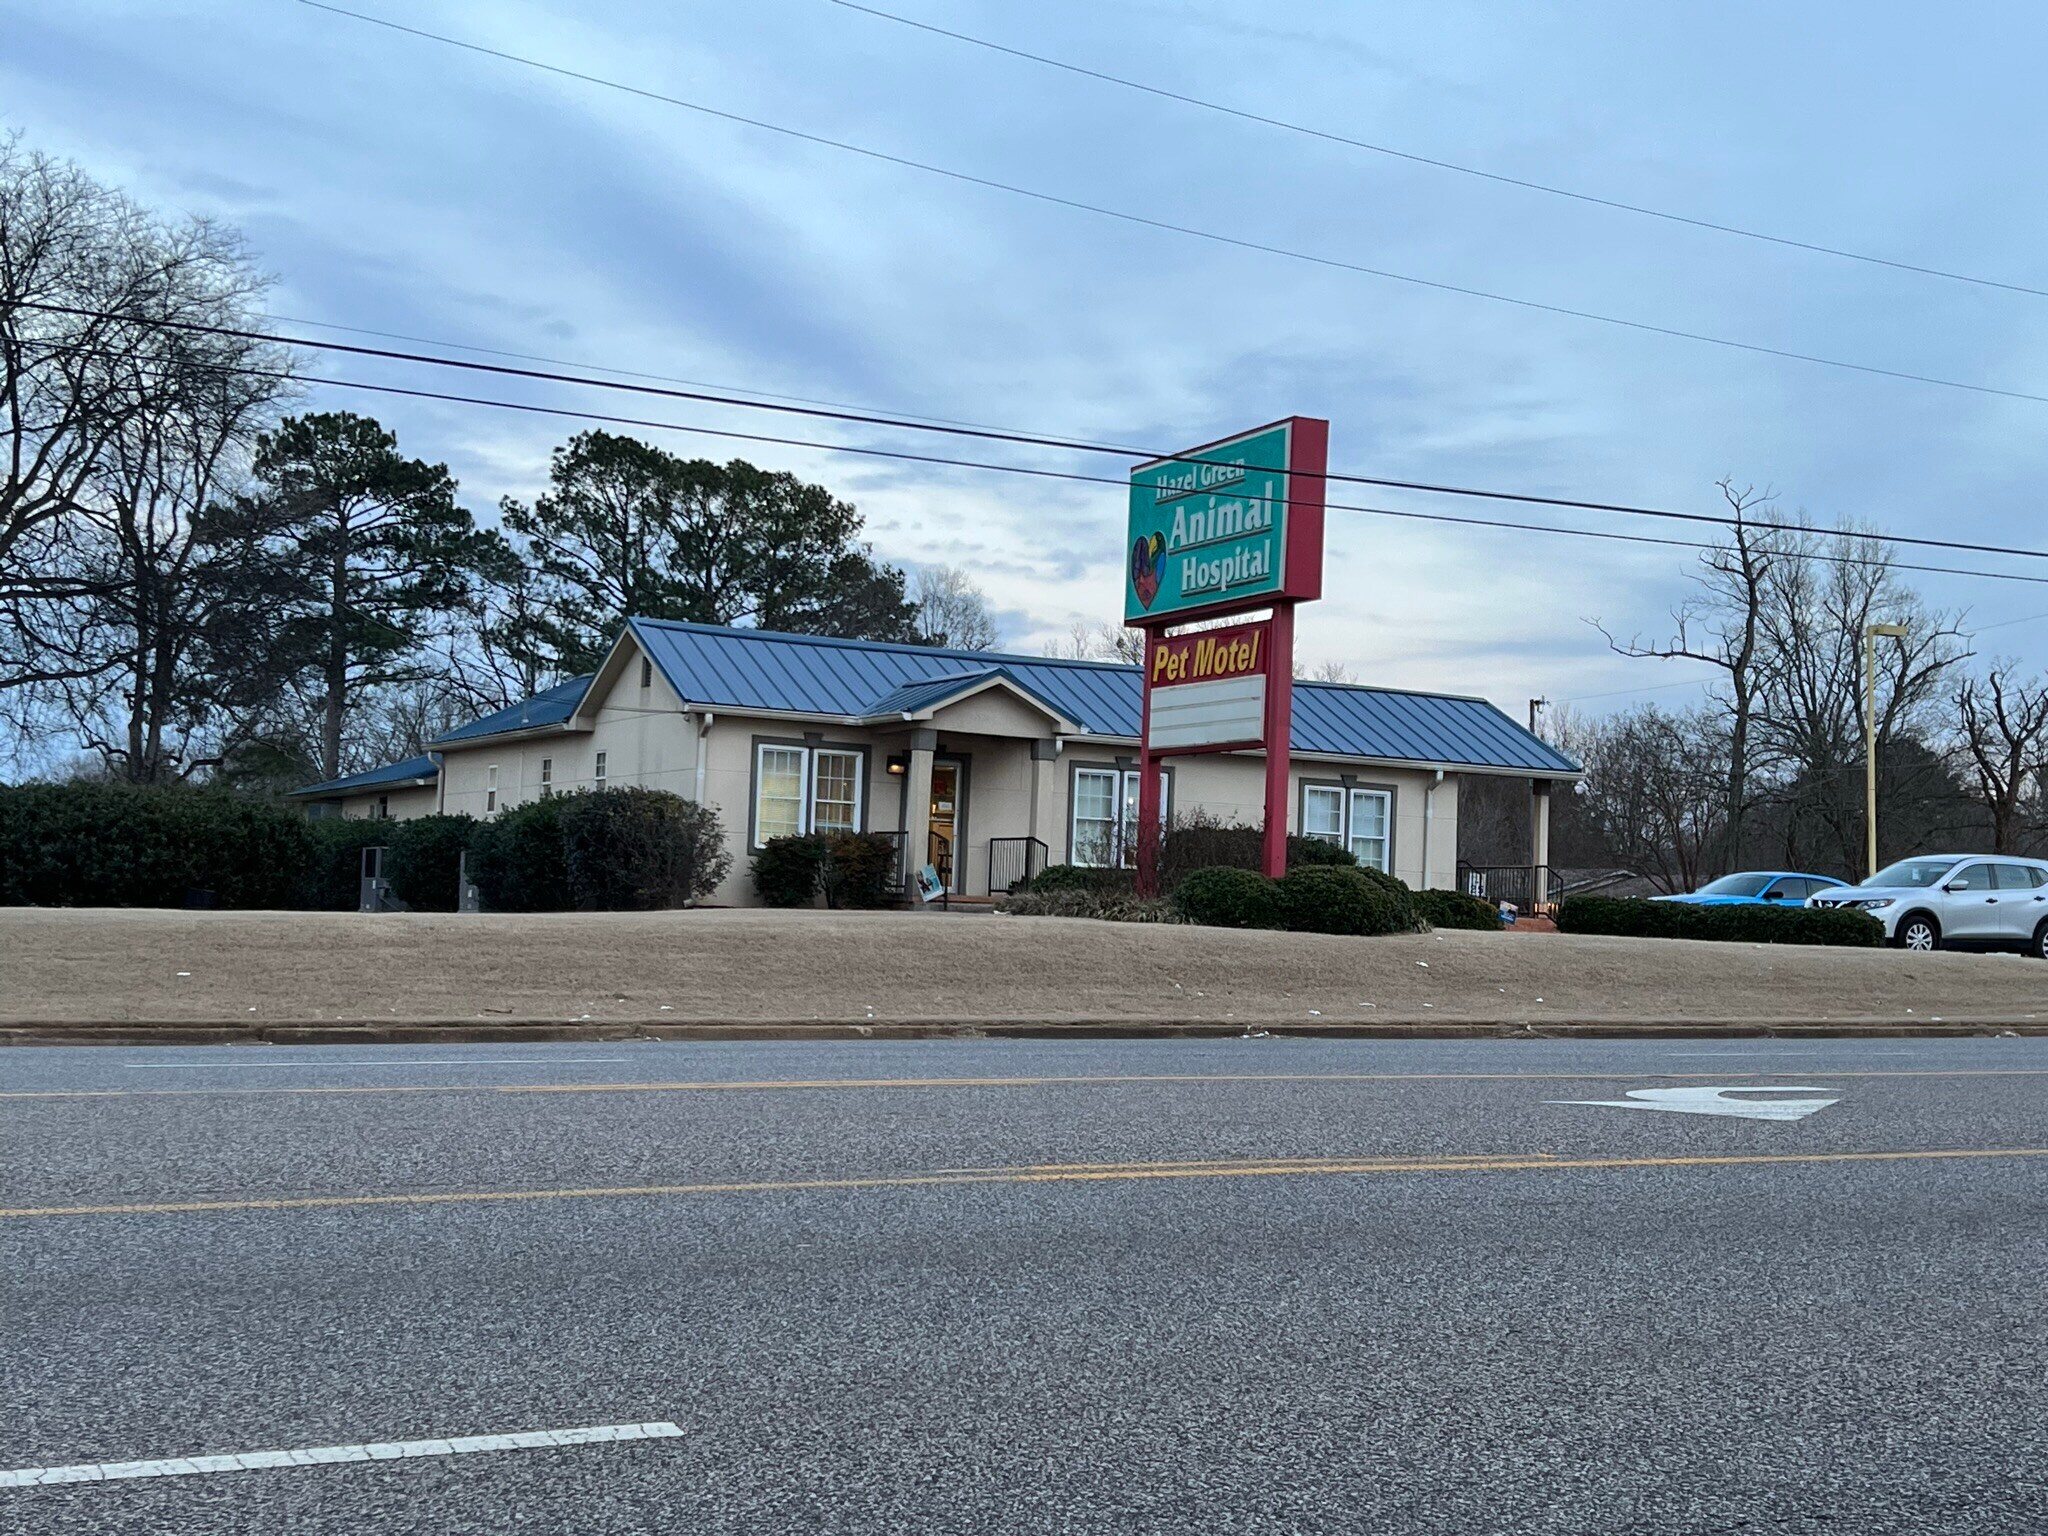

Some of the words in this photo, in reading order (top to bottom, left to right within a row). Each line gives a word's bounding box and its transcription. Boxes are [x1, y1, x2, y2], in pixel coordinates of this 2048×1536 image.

[1156, 466, 1197, 500] Hazel
[1200, 457, 1246, 487] Green
[1168, 480, 1273, 549] Animal
[1181, 539, 1270, 592] Hospital
[1152, 645, 1190, 682] Pet
[1192, 630, 1260, 678] Motel
